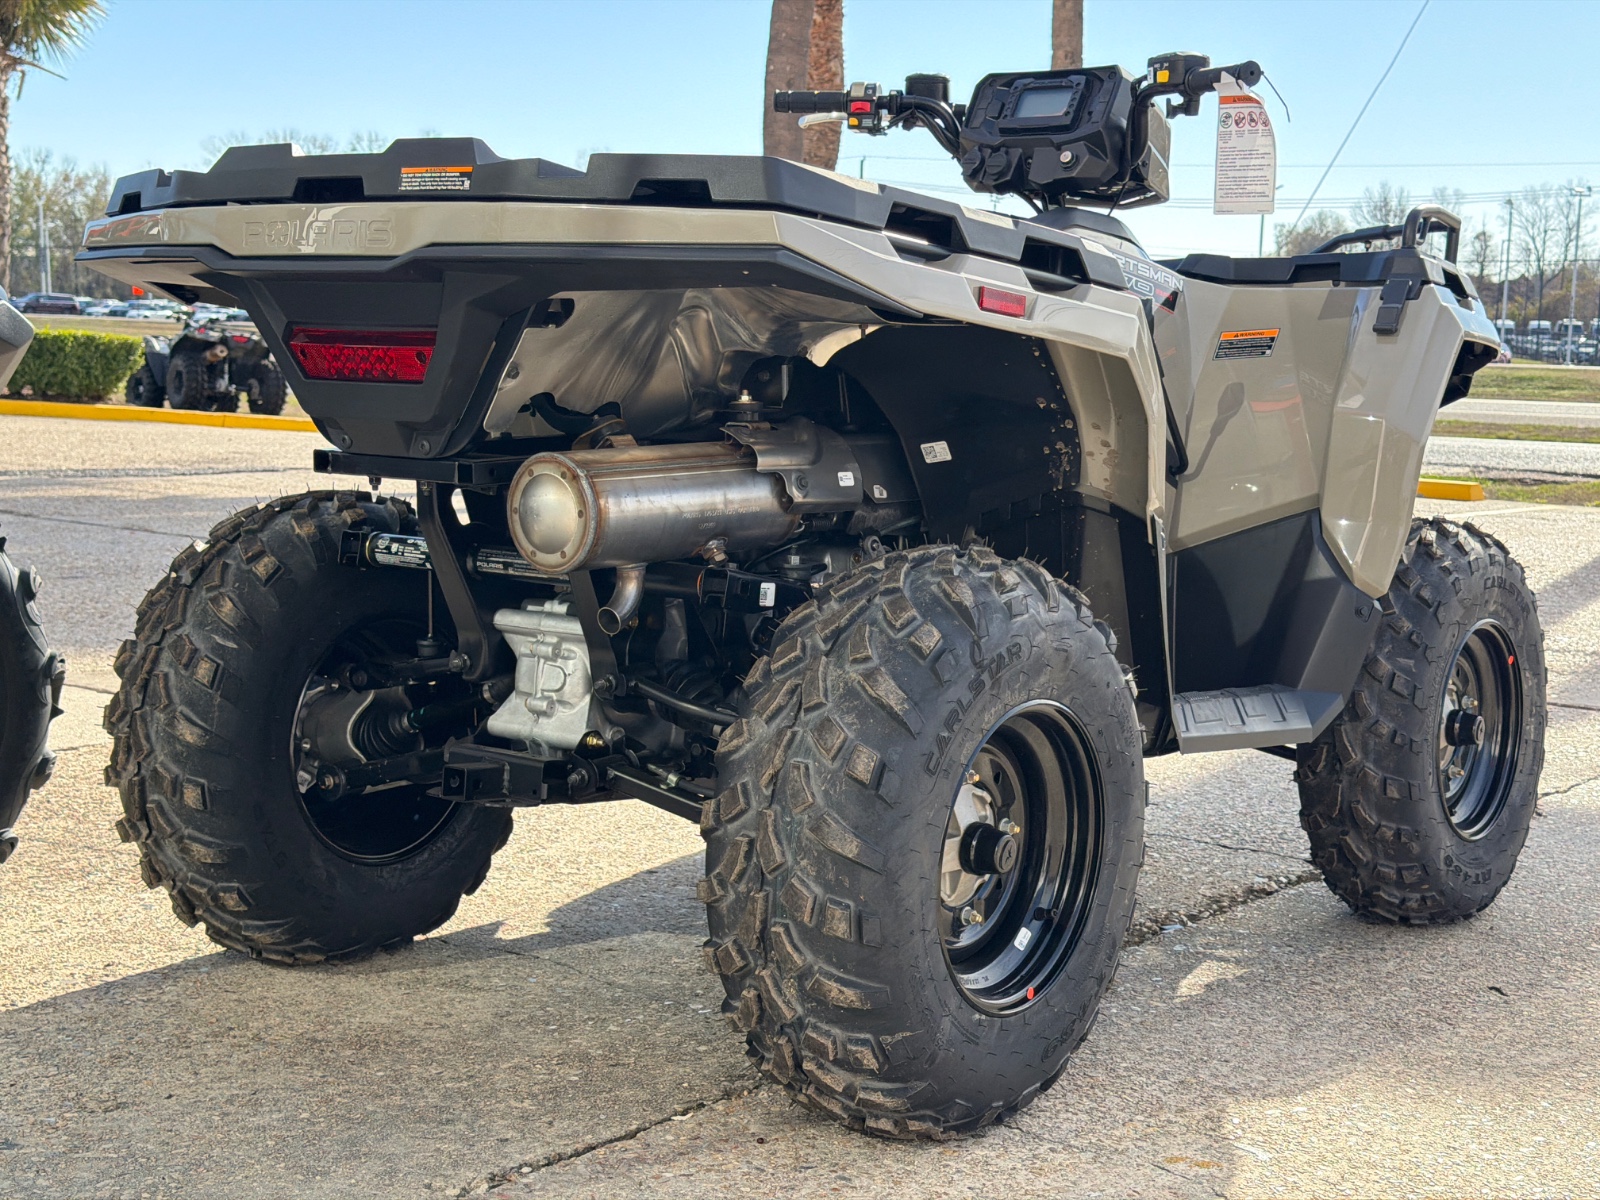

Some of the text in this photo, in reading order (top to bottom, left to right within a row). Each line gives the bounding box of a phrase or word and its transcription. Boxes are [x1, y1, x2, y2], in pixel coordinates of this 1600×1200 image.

[243, 220, 395, 247] POLARIS
[1112, 252, 1184, 292] RTSMAN
[476, 561, 504, 569] POLARIS
[924, 641, 1022, 778] CARLSTAR
